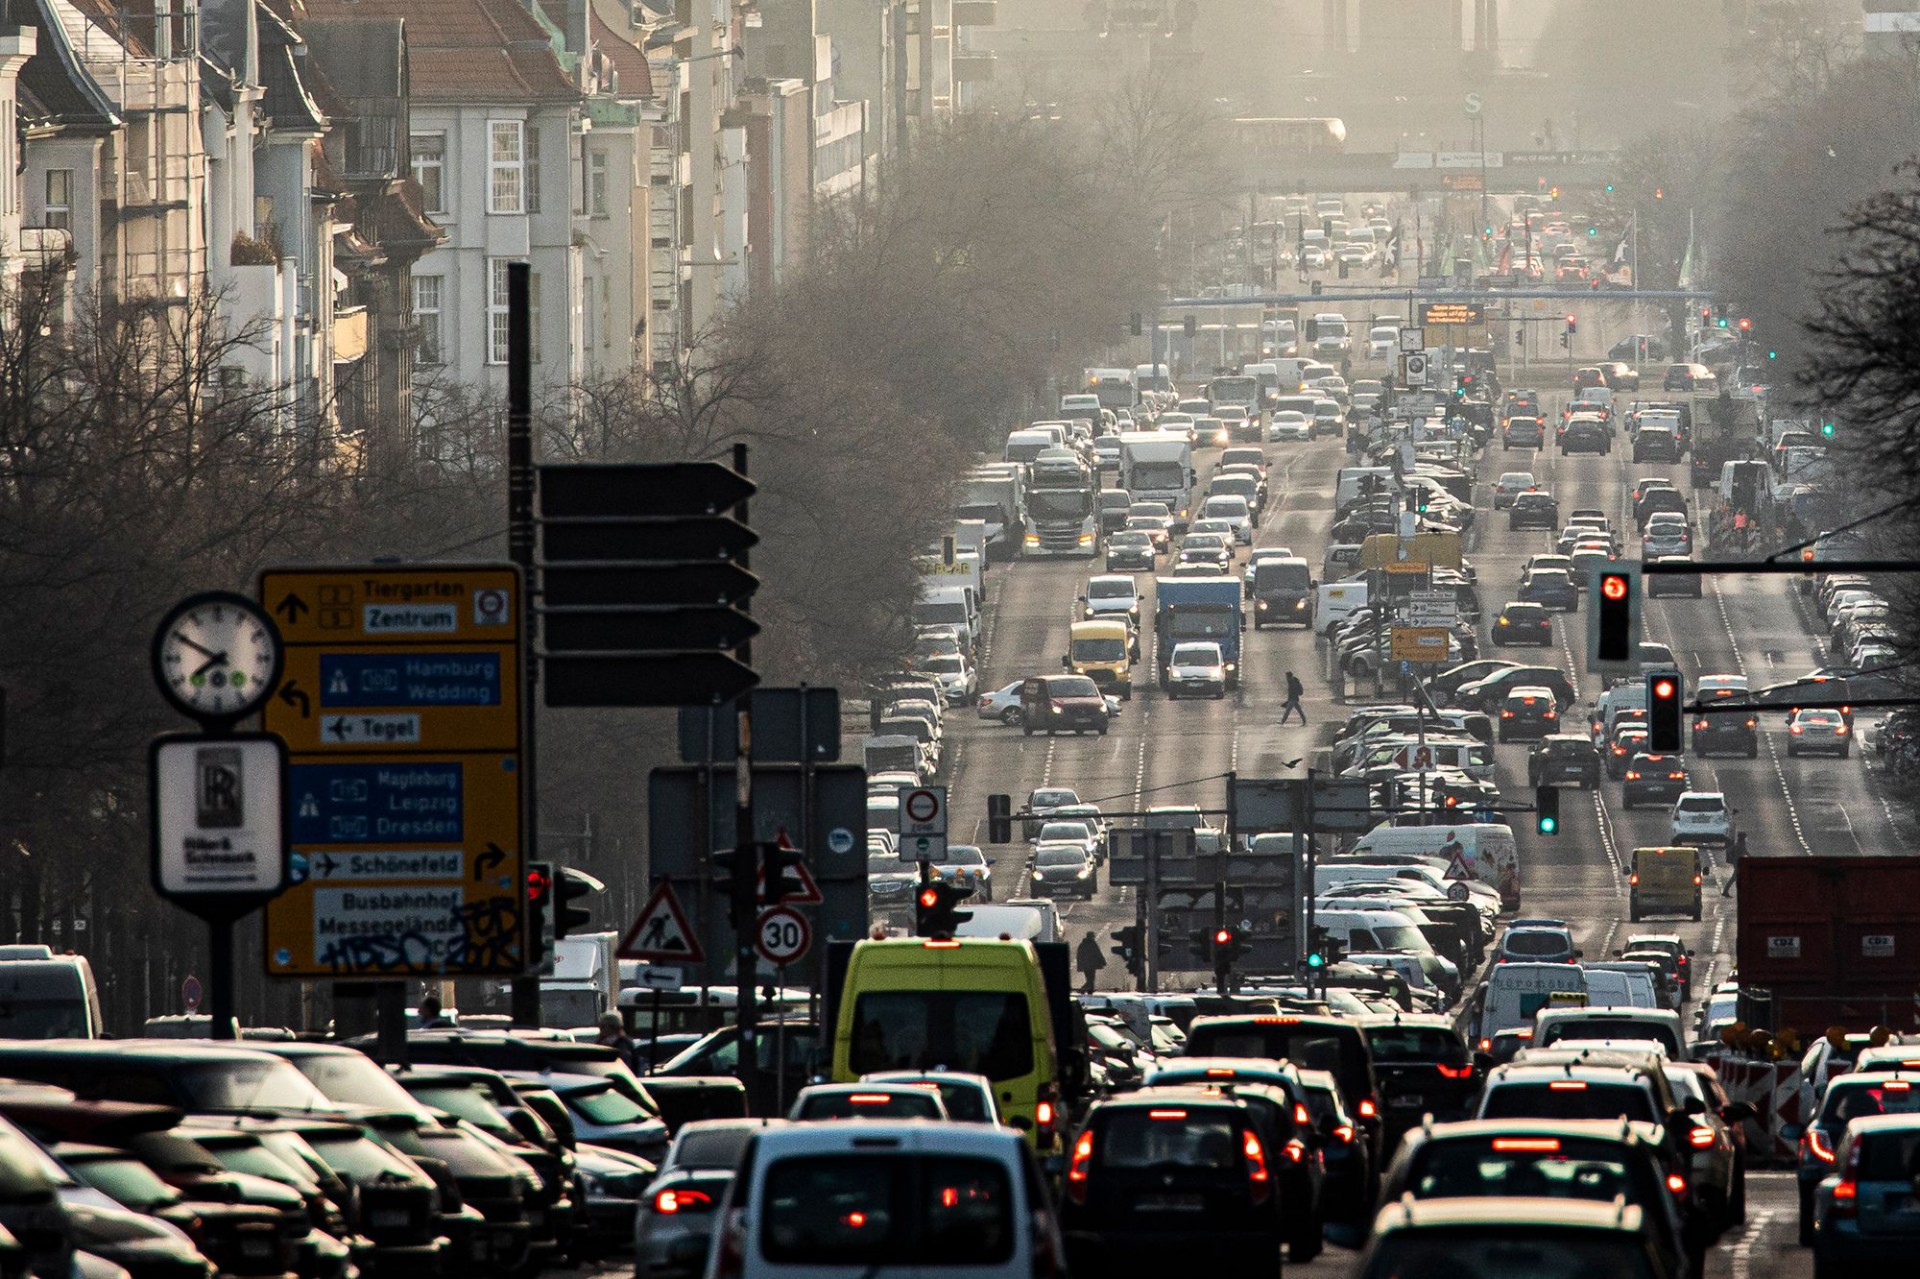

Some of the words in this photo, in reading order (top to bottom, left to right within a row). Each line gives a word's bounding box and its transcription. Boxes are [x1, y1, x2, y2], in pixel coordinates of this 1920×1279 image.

[363, 579, 465, 602] Tiergarten
[369, 608, 453, 628] Zentrum
[405, 660, 495, 682] Hamburg
[408, 684, 492, 704] Wedding
[363, 718, 413, 738] Tegel
[377, 770, 457, 791] Magdeburg
[389, 794, 457, 815] Leipzig
[376, 817, 457, 836] Dresden
[351, 853, 458, 875] Schönefeld
[343, 893, 458, 910] Busbahnhof
[765, 922, 799, 949] 30
